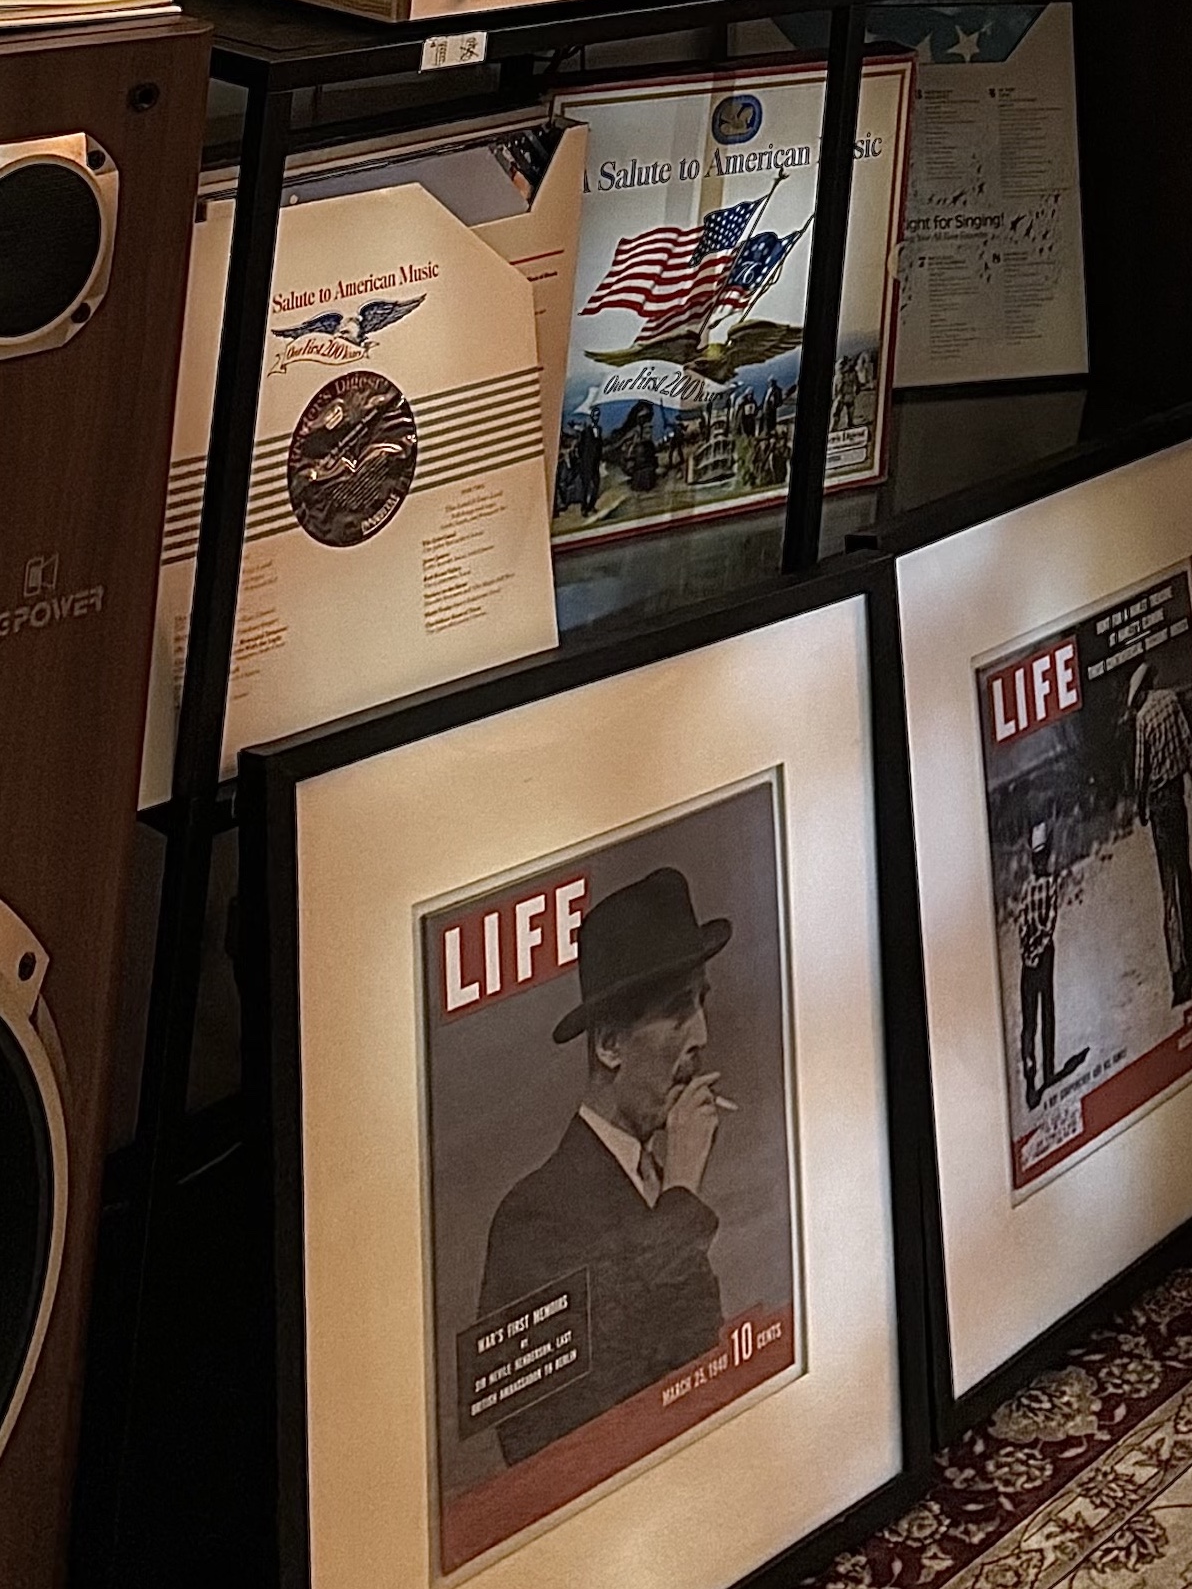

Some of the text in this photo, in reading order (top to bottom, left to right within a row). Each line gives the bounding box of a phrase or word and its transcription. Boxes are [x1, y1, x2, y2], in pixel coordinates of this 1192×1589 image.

[597, 158, 672, 192] Salute
[678, 157, 701, 182] to
[703, 143, 811, 179] American
[933, 214, 953, 230] for
[271, 260, 441, 314] Salute to American Music
[320, 338, 344, 360] 200
[603, 374, 633, 395] Our
[659, 370, 700, 401] 200
[991, 642, 1079, 743] LIFE
[443, 877, 586, 1013] LIFE
[476, 1327, 504, 1354] WAR'S
[506, 1313, 530, 1339] FIRST
[730, 1321, 783, 1367] 10 CENTS
[661, 1375, 692, 1408] MARCH
